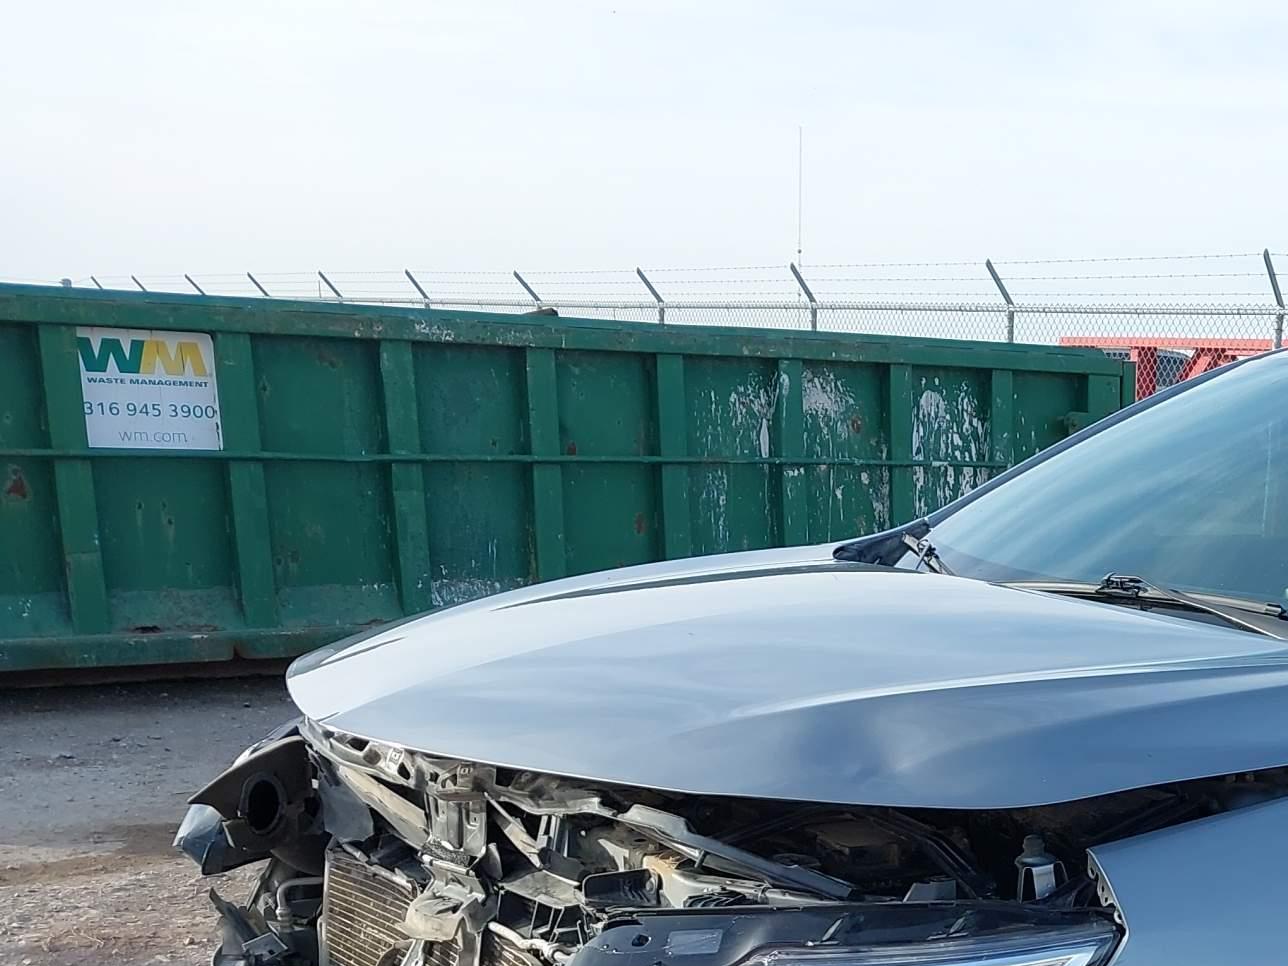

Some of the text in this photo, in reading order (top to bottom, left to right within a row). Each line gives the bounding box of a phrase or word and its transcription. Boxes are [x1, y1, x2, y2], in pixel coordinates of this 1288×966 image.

[77, 336, 208, 377] WM
[86, 376, 209, 388] WASTE MANAGEMENT
[84, 401, 216, 419] 316 945 3900
[119, 431, 188, 443] wm.com
